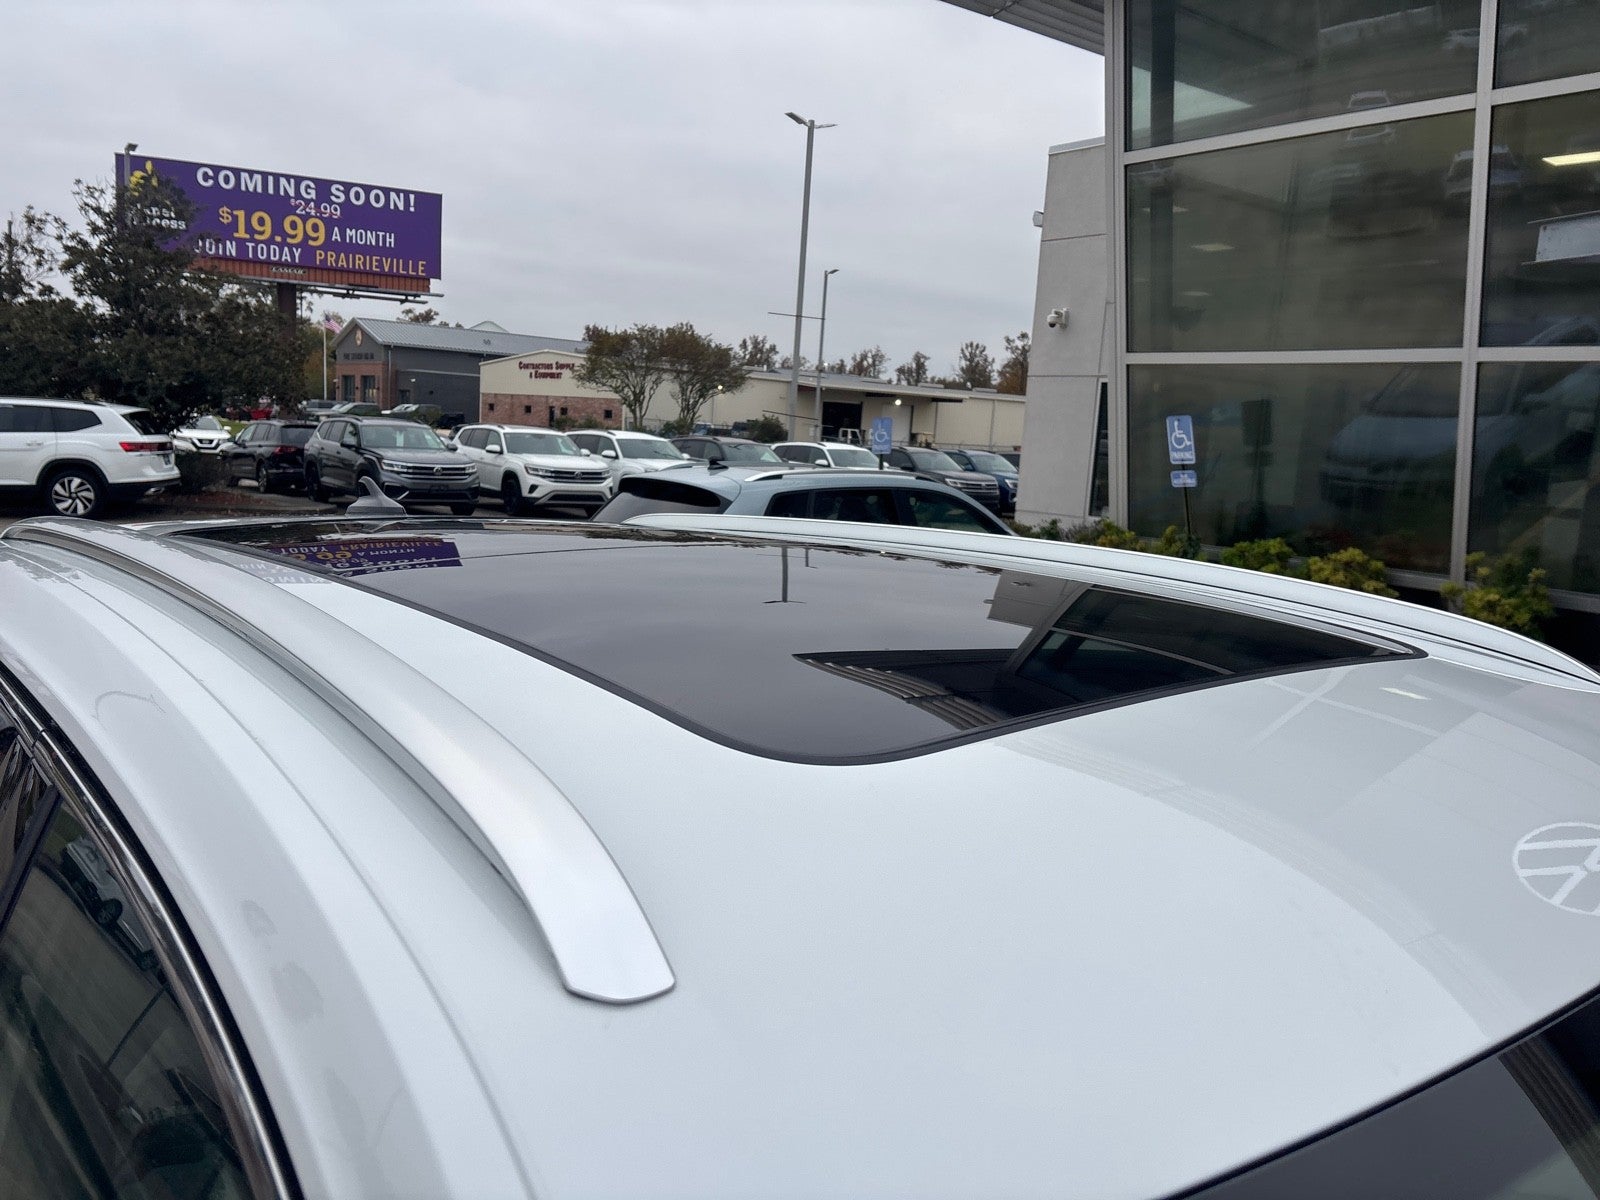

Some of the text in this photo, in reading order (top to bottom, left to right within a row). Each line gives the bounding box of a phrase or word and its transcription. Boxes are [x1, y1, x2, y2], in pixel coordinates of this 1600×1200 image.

[196, 166, 415, 212] COMING SOON!
[218, 205, 326, 247] $19.99
[290, 199, 341, 219] $24.99
[331, 226, 395, 248] A MONTH
[194, 238, 427, 276] JOIN TODAY PRAIRIEVILLE
